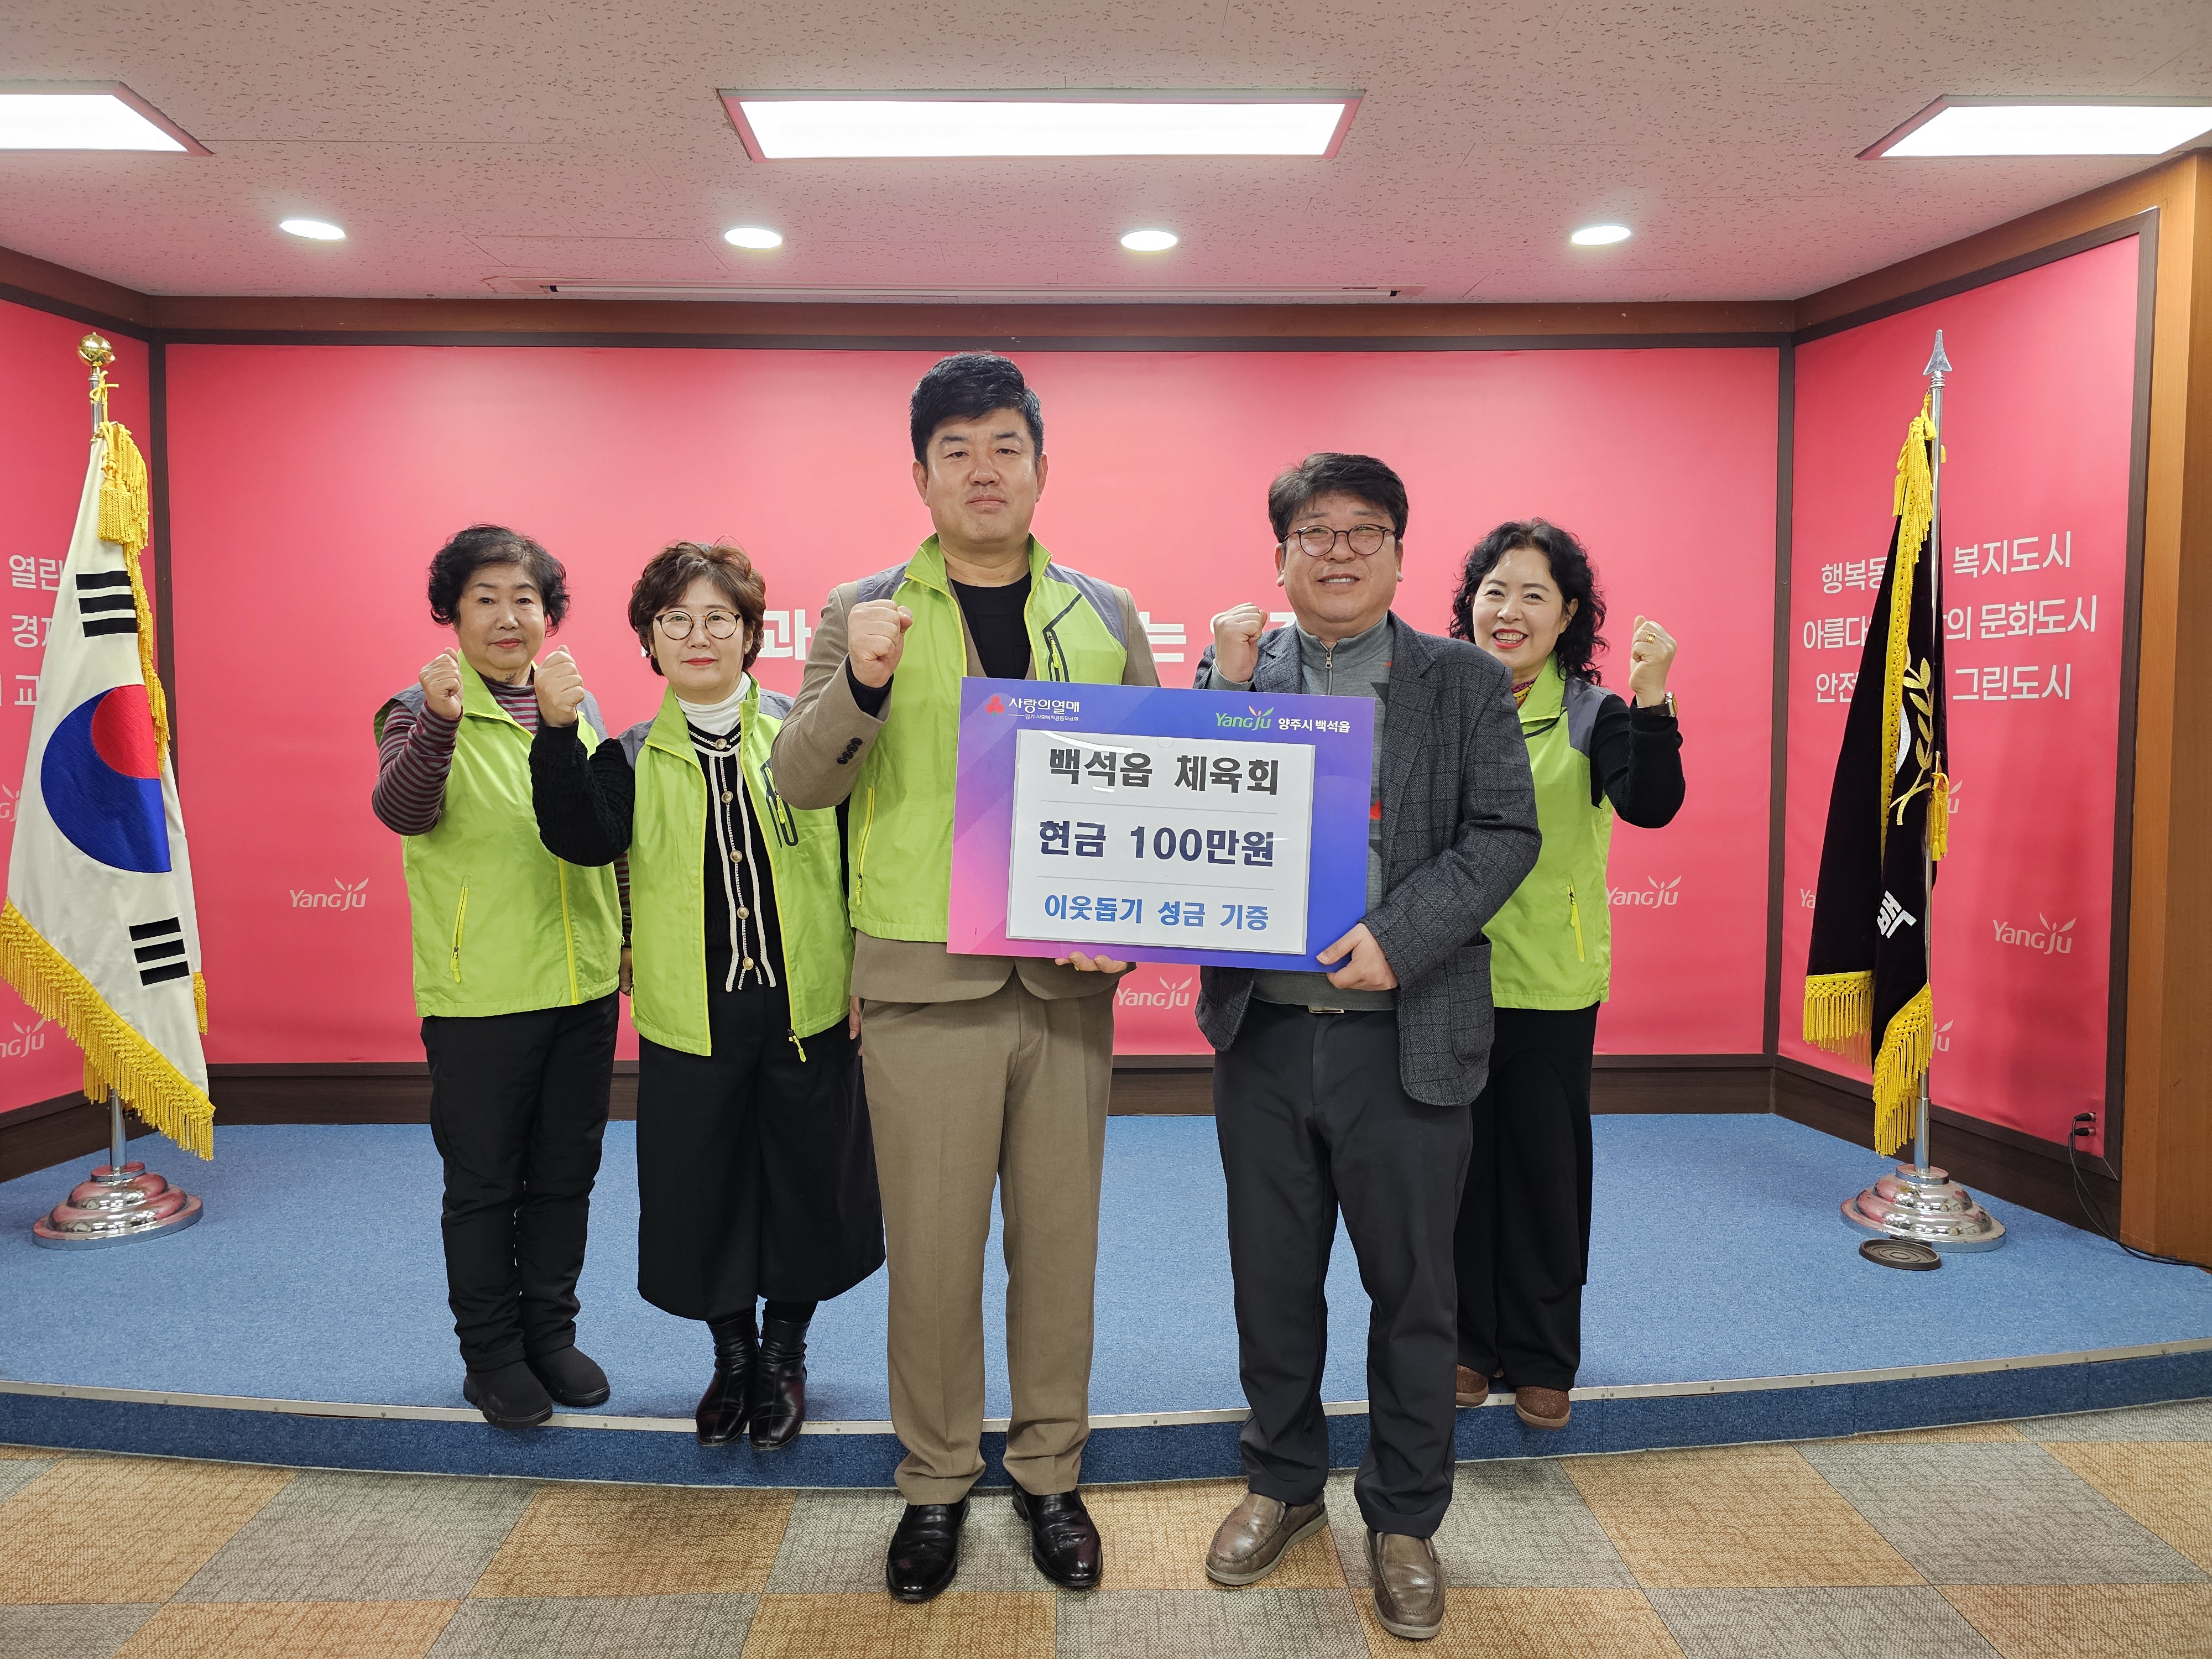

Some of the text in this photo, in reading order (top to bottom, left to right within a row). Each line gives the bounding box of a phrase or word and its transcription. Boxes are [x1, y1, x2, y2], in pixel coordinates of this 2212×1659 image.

[1953, 530, 2071, 578] 복지도시
[1803, 615, 1872, 649] 아름다
[1979, 595, 2097, 639] 문화도시
[1953, 663, 2071, 701] 그린도시
[1008, 698, 1080, 715] 사랑의열매
[1278, 718, 1351, 733] 양주시 백석읍
[1048, 748, 1279, 796] 백석읍 체육회
[1039, 821, 1274, 868] 현금 100만원
[1044, 894, 1270, 931] 이웃돕기 성금 기증
